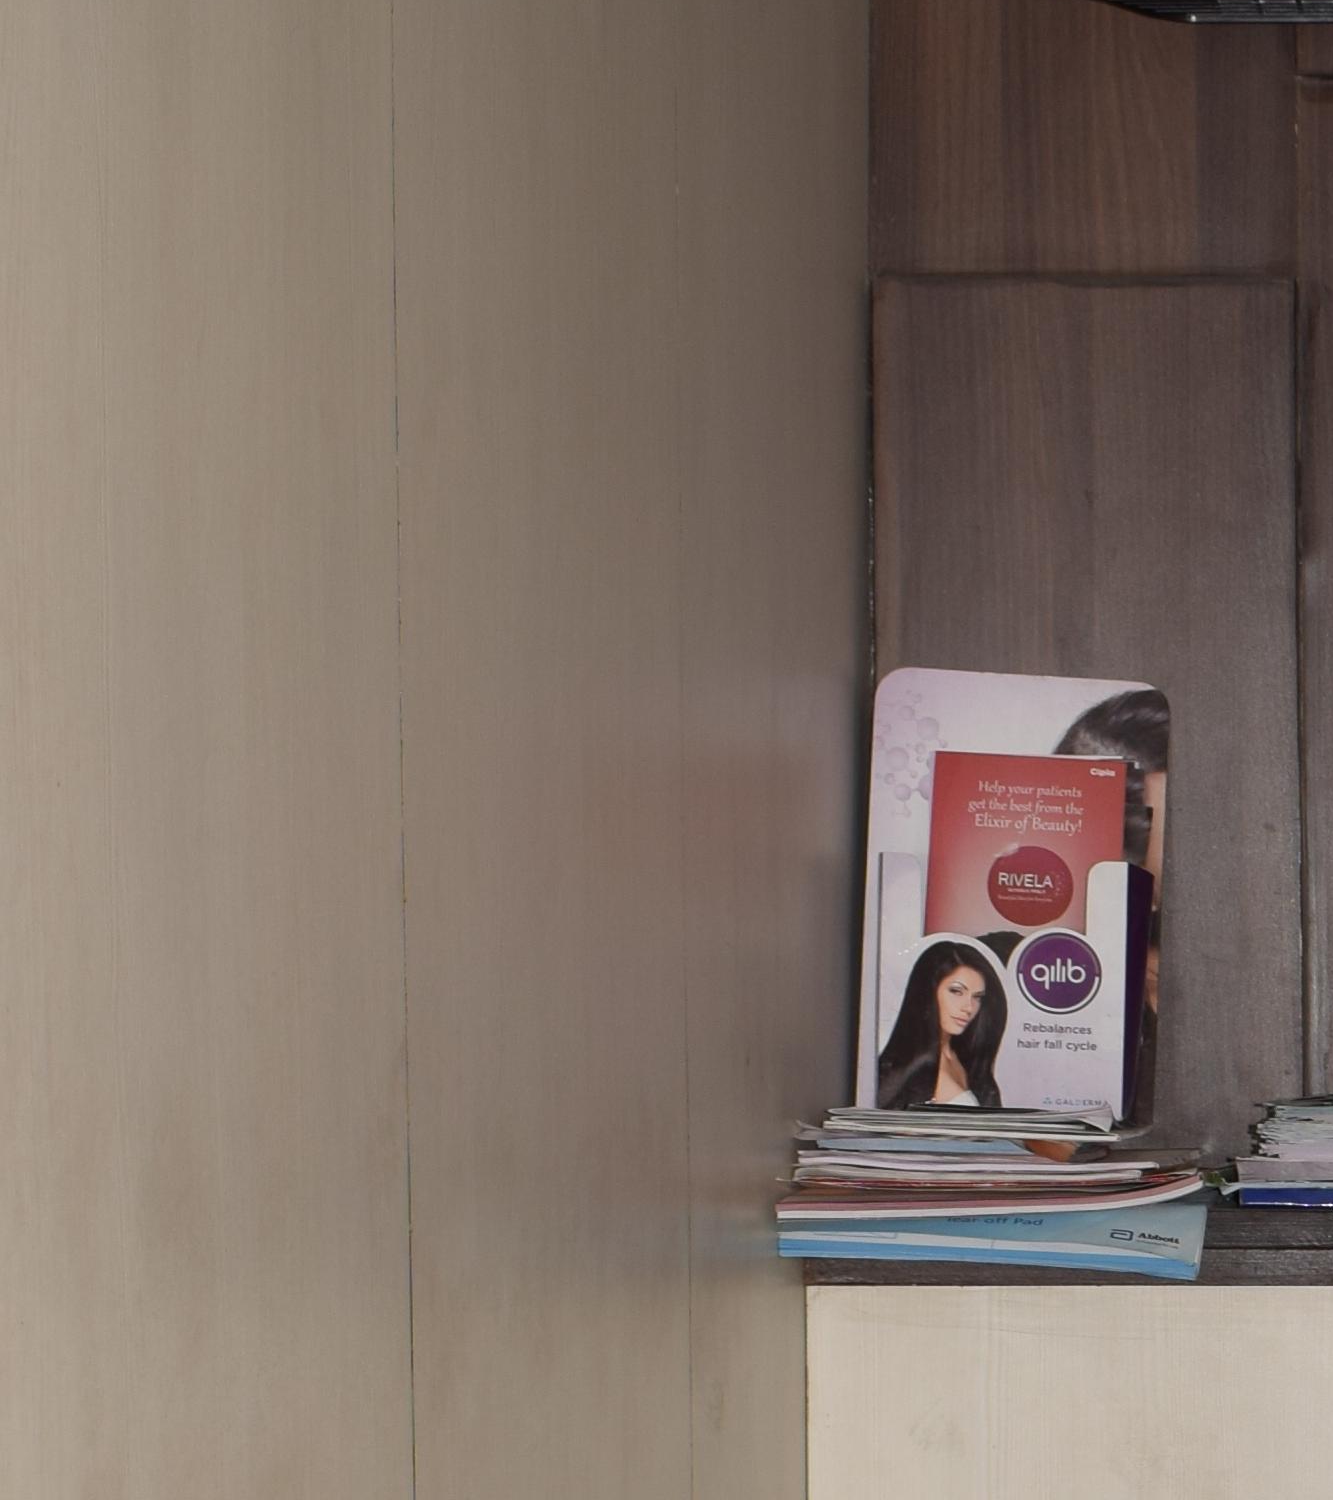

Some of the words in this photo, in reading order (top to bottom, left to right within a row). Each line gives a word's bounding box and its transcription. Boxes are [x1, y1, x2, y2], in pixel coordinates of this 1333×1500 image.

[978, 780, 1006, 797] Help
[1007, 786, 1034, 797] your
[1036, 786, 1083, 799] patients
[967, 799, 986, 813] get
[988, 798, 1008, 811] the
[1009, 799, 1033, 812] best
[1034, 800, 1063, 816] from
[1065, 802, 1084, 816] the
[974, 812, 1012, 828] Elixir
[1014, 815, 1029, 835] of
[1031, 815, 1083, 837] Beauty!
[997, 871, 1054, 889] RIVELA
[1023, 1022, 1093, 1036] Rebalances
[1016, 1038, 1041, 1050] hair
[1044, 1039, 1063, 1050] fall
[1065, 1040, 1098, 1053] cycle
[1013, 1217, 1045, 1227] Pad
[1137, 1232, 1181, 1245] Abbott
